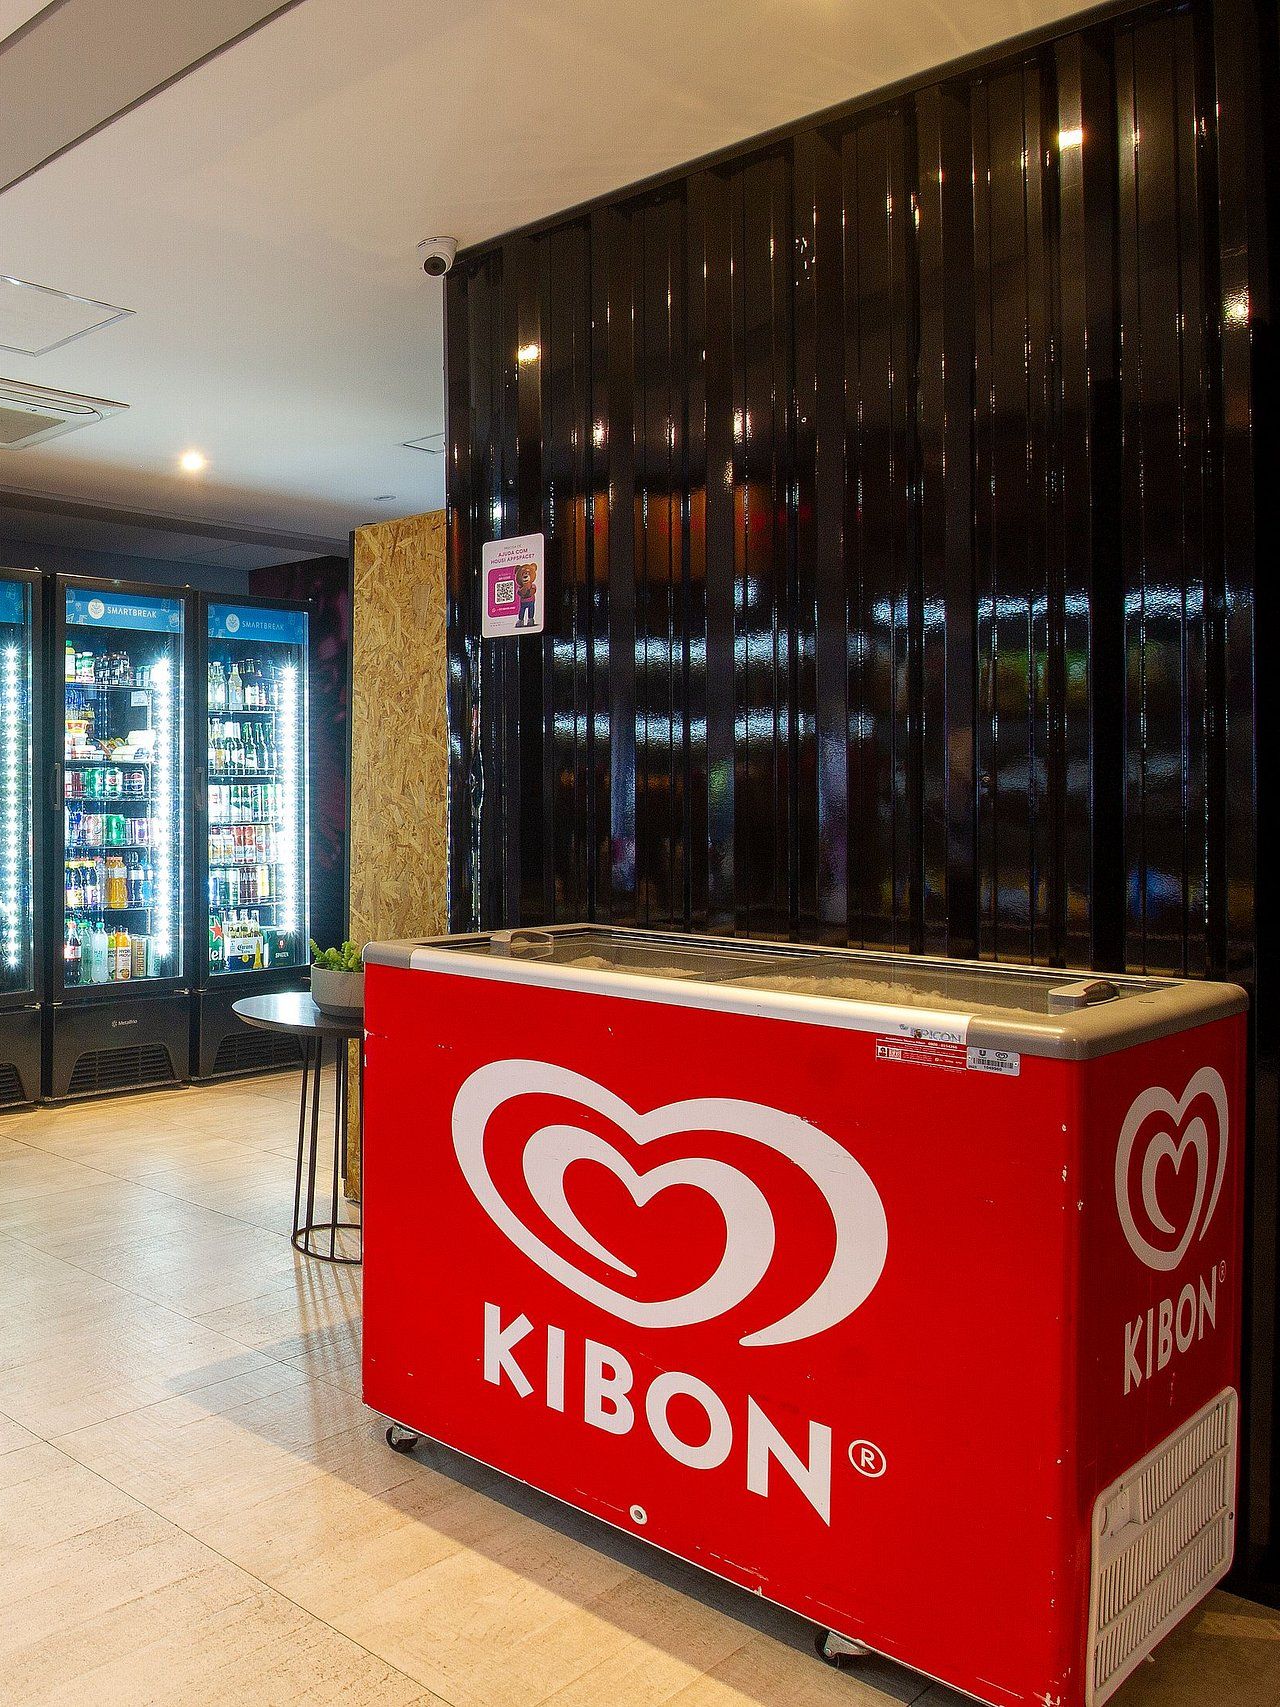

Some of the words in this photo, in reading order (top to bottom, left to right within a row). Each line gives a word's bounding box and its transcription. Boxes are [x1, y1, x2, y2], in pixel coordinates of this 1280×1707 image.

[107, 606, 157, 619] SMARTBREAK
[242, 620, 285, 632] SMARTBREAK
[1124, 1266, 1217, 1396] KIBON
[484, 1302, 832, 1527] KIBON
